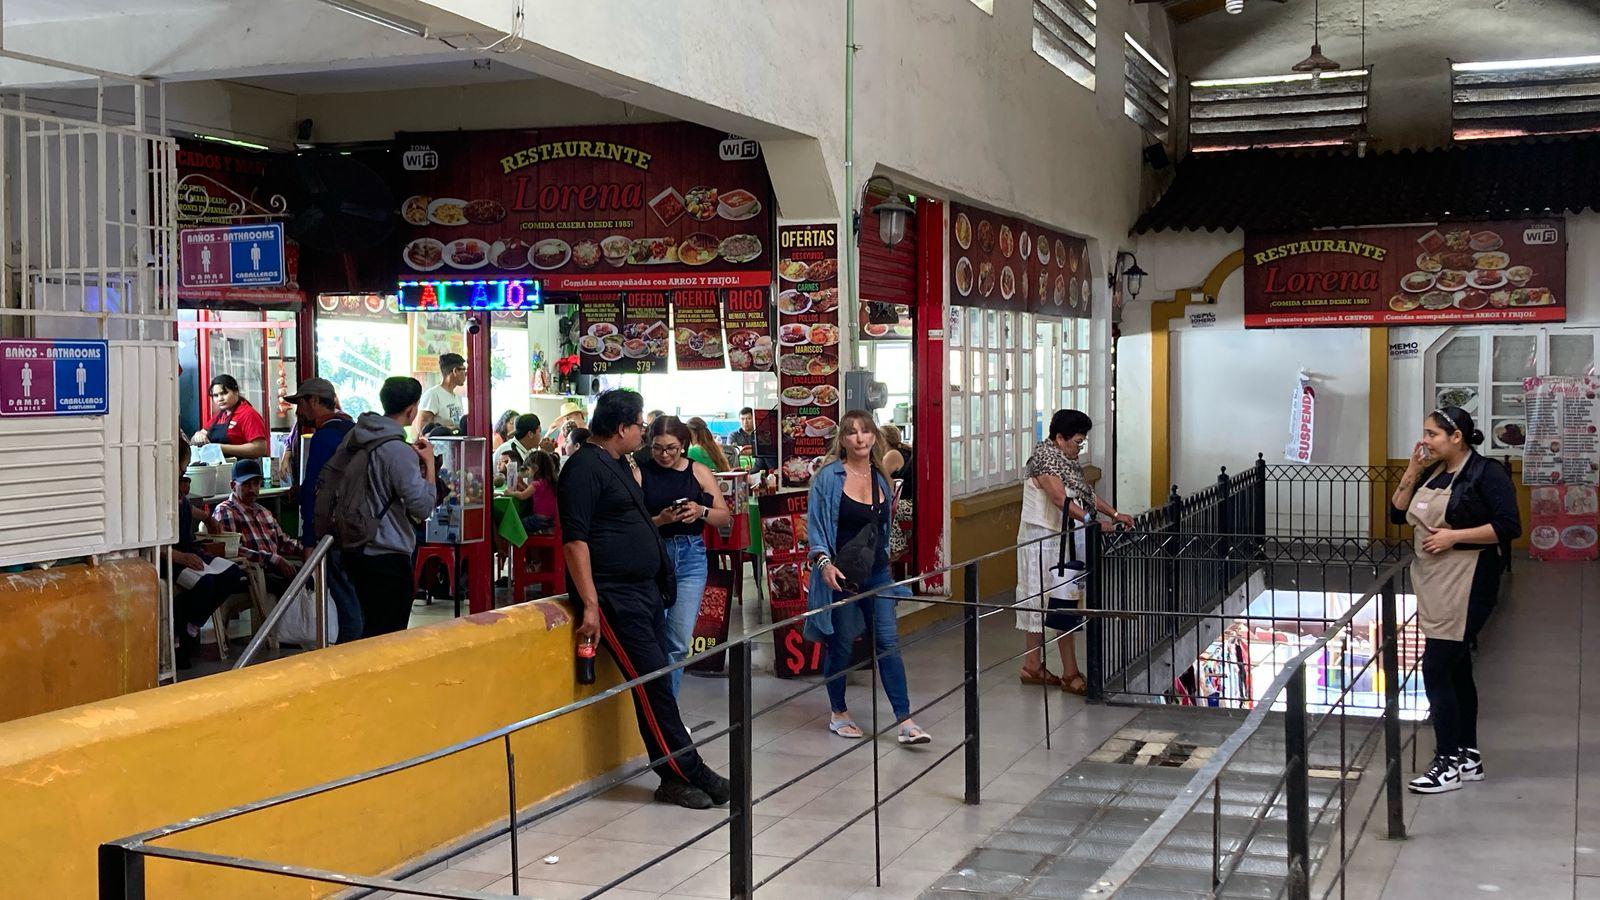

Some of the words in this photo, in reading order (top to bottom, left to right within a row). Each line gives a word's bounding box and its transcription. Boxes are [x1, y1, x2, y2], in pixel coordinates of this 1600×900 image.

[721, 142, 756, 156] WiFi
[404, 153, 436, 167] WiFi
[500, 141, 652, 174] RESTAURANTE
[512, 176, 643, 214] Lorena
[556, 222, 587, 230] CASERA
[588, 221, 614, 230] DESDE
[614, 220, 634, 230] 1985!
[187, 232, 215, 244] BAÑOS
[223, 230, 274, 242] BATHROOMS
[782, 230, 834, 248] OFERTAS
[1526, 230, 1556, 242] WiFi
[1254, 238, 1387, 266] RESTAURANTE
[560, 280, 597, 288] ¡Comidas
[598, 278, 652, 288] acompañadas
[668, 278, 698, 286] ARROZ
[708, 276, 740, 286] FRIJOL!
[1264, 265, 1380, 294] Lorena
[797, 283, 819, 292] CARNES
[628, 293, 664, 308] OFERTA
[674, 289, 716, 307] OFERTA
[729, 290, 762, 310] RICO
[1304, 316, 1338, 324] especiales
[1415, 312, 1462, 321] acompañadas
[6, 344, 37, 358] BAÑOS
[46, 348, 100, 358] BATHROOMS
[795, 345, 823, 354] MARISCOS
[1390, 342, 1418, 350] MEMO
[592, 360, 607, 372] $79
[636, 360, 651, 371] $79
[798, 407, 820, 415] CALDOS
